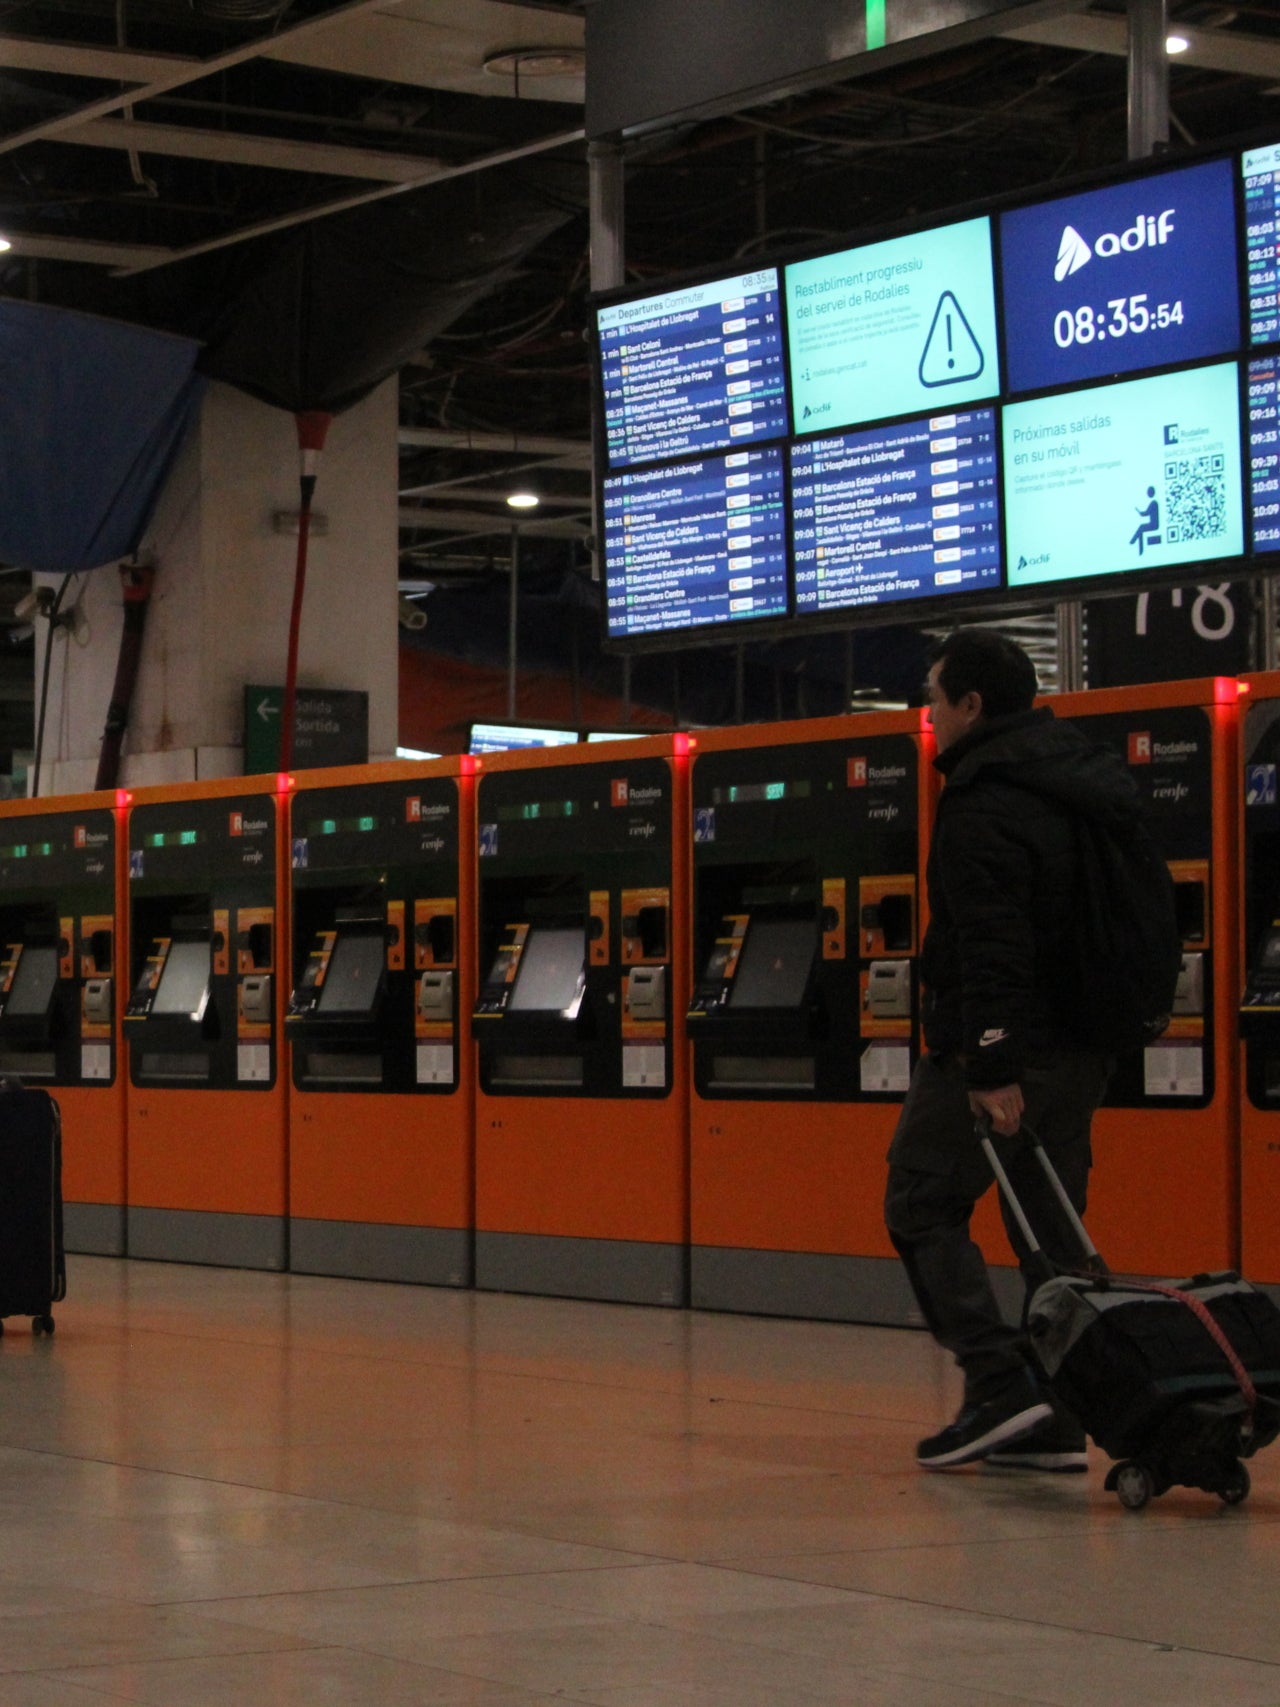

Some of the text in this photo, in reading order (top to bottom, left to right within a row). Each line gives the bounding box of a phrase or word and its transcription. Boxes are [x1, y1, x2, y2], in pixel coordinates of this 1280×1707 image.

[1094, 209, 1176, 258] adif
[794, 258, 922, 299] Restabliment progressiu
[617, 292, 704, 321] Departures Commuter
[796, 303, 812, 319] del
[814, 298, 846, 315] servei
[847, 291, 861, 307] de
[864, 282, 910, 304] Rodalies
[660, 316, 669, 326] de
[669, 311, 699, 326] Llobregat
[1054, 294, 1184, 348] 08:35:54
[627, 343, 640, 354] Sant
[628, 361, 655, 374] Martorell
[655, 356, 679, 368] Central
[630, 381, 659, 394] Barcelona
[659, 376, 682, 388] Estació
[682, 373, 690, 383] de
[691, 370, 712, 383] França
[633, 423, 646, 434] Sant
[667, 417, 676, 427] de
[676, 414, 700, 425] Calders
[1013, 413, 1111, 444] Próximas salidas
[820, 438, 844, 450] Mataró
[1014, 439, 1080, 465] en su móvil
[821, 458, 860, 473] L'Hospitalet
[861, 454, 870, 464] de
[871, 450, 904, 465] Llobregat
[629, 471, 664, 485] L'Hospitalet
[664, 468, 673, 478] de
[673, 465, 703, 478] Llobregat
[822, 480, 855, 492] Barcelona
[856, 474, 881, 487] Estació
[881, 472, 891, 482] de
[891, 469, 915, 482] França
[661, 488, 682, 499] Centre
[822, 501, 856, 514] Barcelona
[856, 496, 881, 508] Estació
[882, 494, 892, 504] de
[892, 491, 916, 504] França
[631, 533, 645, 543] Sant
[645, 531, 666, 542] Vicenç
[666, 529, 674, 538] de
[675, 526, 698, 537] Calders
[823, 524, 839, 535] Sant
[839, 521, 862, 534] Vicenç
[863, 518, 872, 529] de
[873, 515, 900, 527] Calders
[824, 544, 854, 556] Martorell
[855, 540, 880, 551] Central
[632, 572, 662, 583] Barcelona
[662, 568, 685, 579] Estació
[685, 566, 693, 576] de
[694, 564, 715, 576] França
[824, 566, 853, 579] Aeroport
[664, 589, 685, 599] Centre
[825, 587, 859, 599] Barcelona
[859, 582, 884, 594] Estació
[885, 580, 895, 590] de
[895, 578, 919, 591] França
[296, 698, 332, 714] Salida
[295, 718, 340, 733] Sortida
[1137, 737, 1198, 756] R Rodalies
[854, 761, 906, 780] R Rodalies
[618, 783, 662, 800] R Rodalies
[1153, 782, 1189, 802] renfe
[868, 804, 898, 822] renfe
[629, 822, 656, 838] renfe
